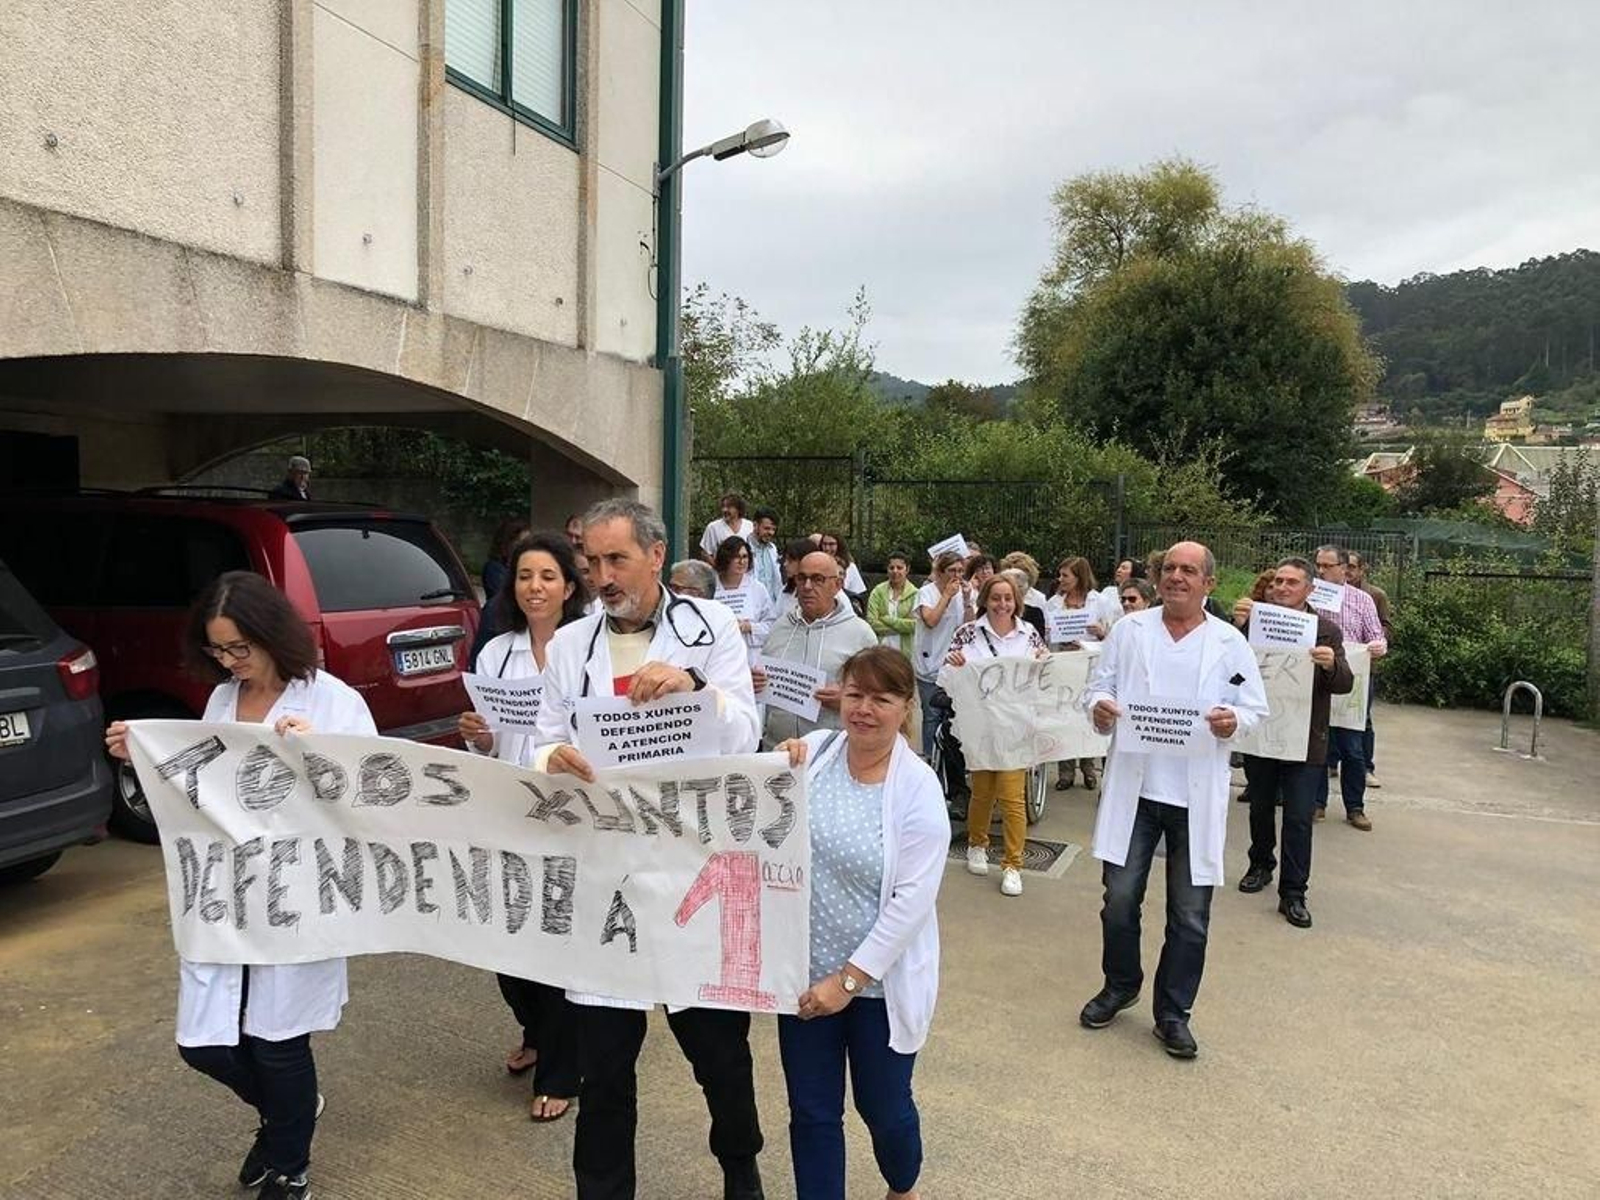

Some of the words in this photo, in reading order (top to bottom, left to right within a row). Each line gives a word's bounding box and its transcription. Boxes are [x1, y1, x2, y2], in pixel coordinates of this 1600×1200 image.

[403, 650, 432, 669] 5814
[433, 648, 453, 665] GNL
[765, 665, 790, 675] TODOS
[475, 685, 507, 696] TODOS
[593, 711, 641, 722] TODOS
[645, 704, 702, 719] XUNTOS
[1127, 703, 1159, 713] TODOS
[1160, 707, 1200, 717] XUNTOS
[499, 716, 536, 726] PRIMAR
[600, 718, 693, 737] DEFENDENDO
[1130, 714, 1193, 727] DEFENDENDO
[1143, 725, 1191, 737] ATENCION
[608, 742, 618, 751] A
[621, 731, 692, 749] ATENCION
[1140, 735, 1185, 745] PRIMARIA
[618, 746, 684, 762] PRIMARIA
[154, 735, 471, 812] TODOS
[518, 771, 798, 849] XUNTOS
[174, 836, 577, 935] DEFENDENDO
[674, 850, 778, 1010] 1
